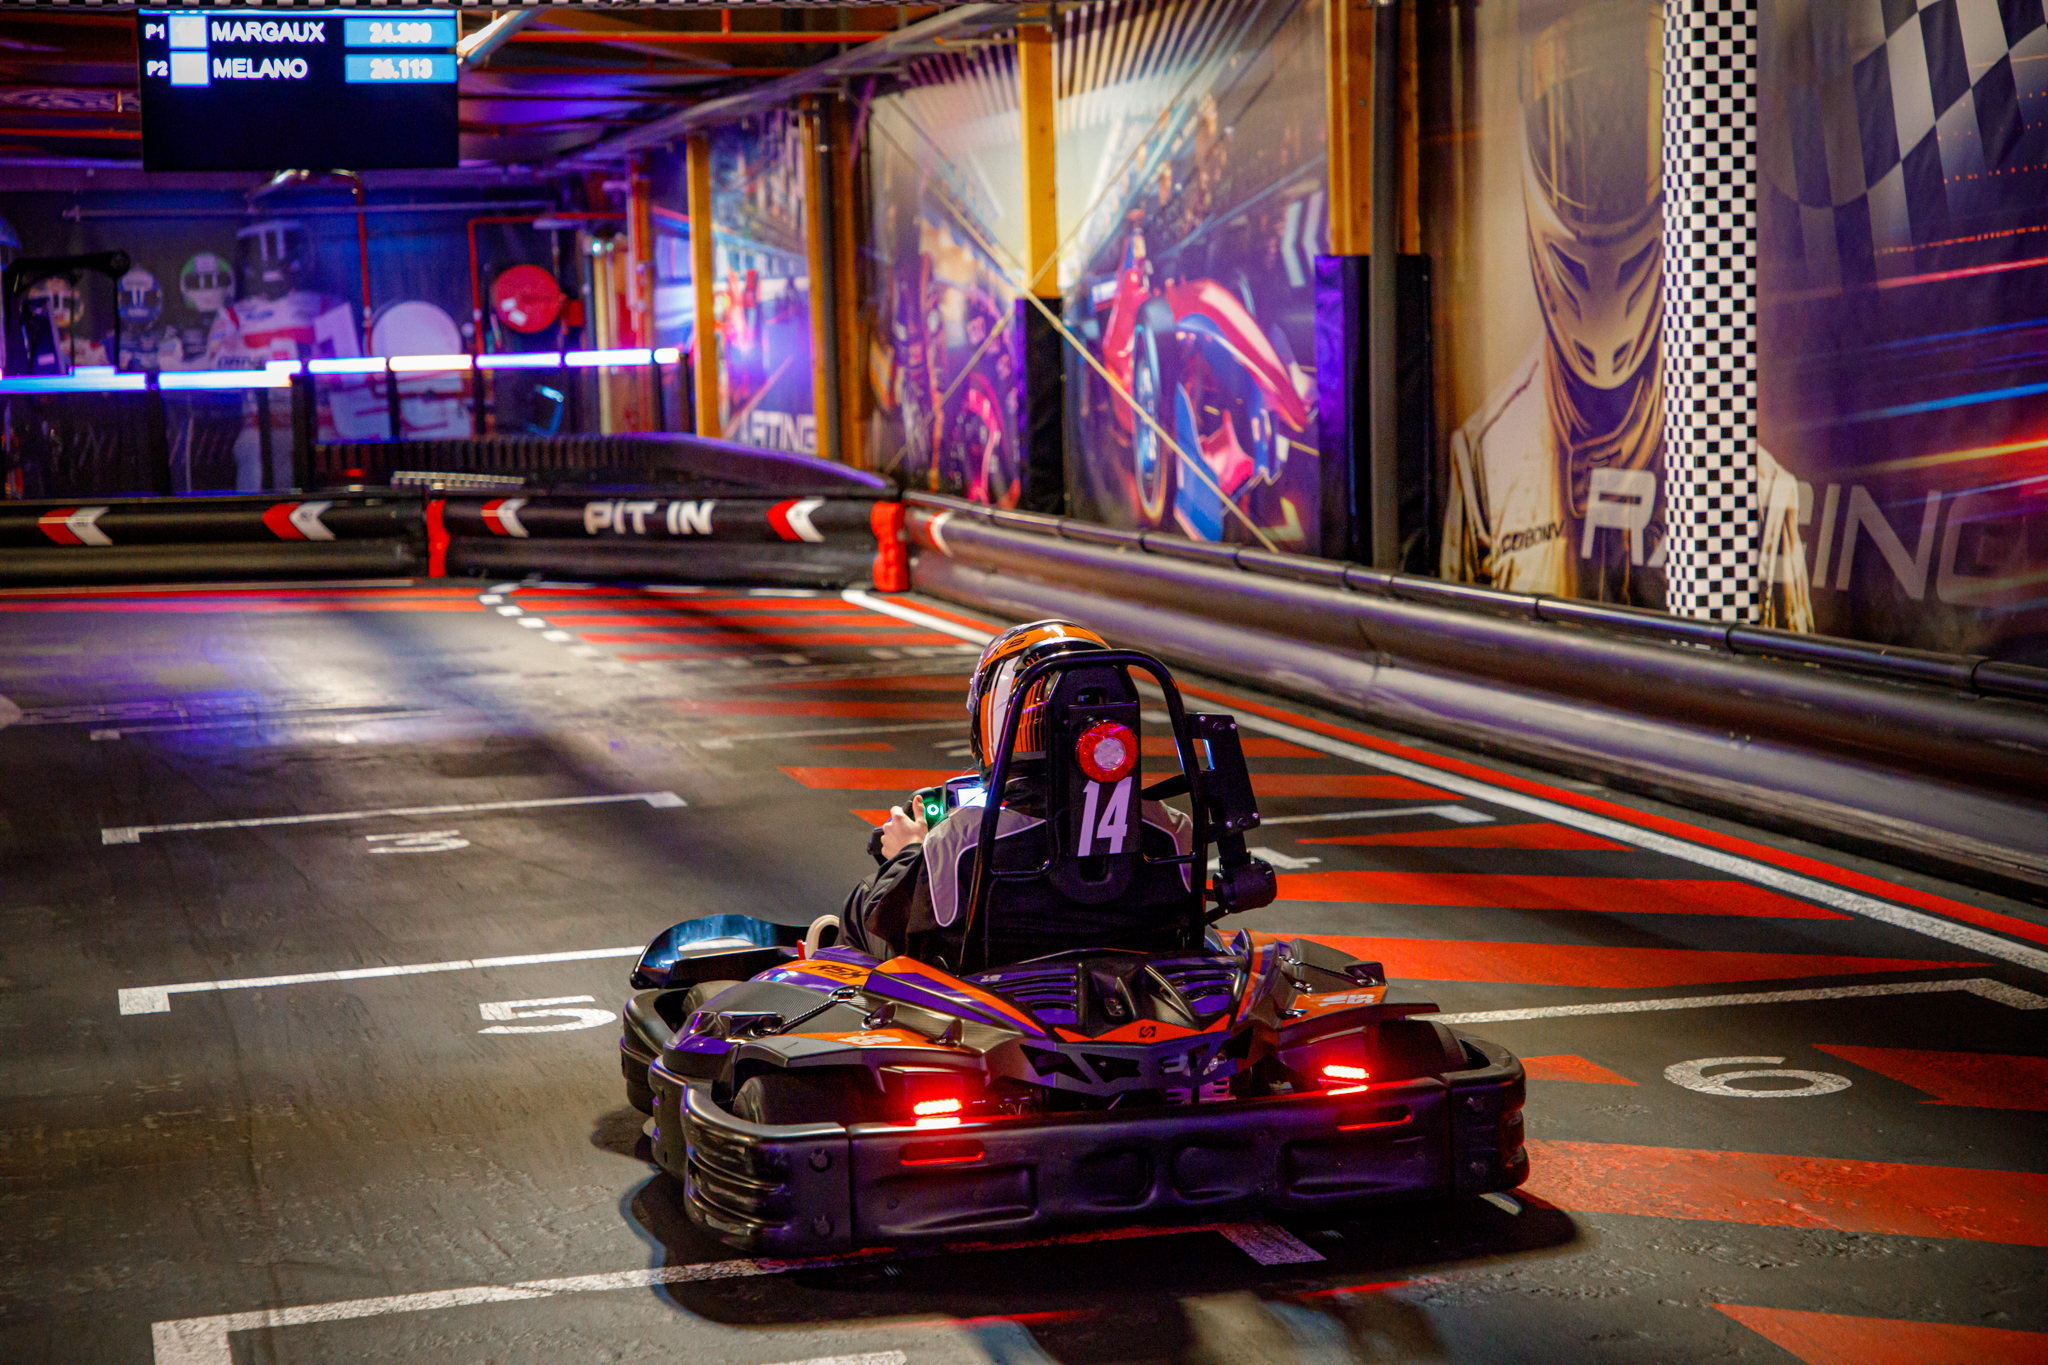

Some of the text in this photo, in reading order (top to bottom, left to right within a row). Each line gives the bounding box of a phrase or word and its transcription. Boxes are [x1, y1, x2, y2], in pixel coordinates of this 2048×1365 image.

[145, 23, 166, 43] P1
[212, 21, 326, 43] MARGAUX
[146, 60, 169, 77] P2
[213, 58, 308, 80] MELANO
[583, 500, 716, 535] PIT IN
[1581, 467, 2030, 608] RING
[1077, 776, 1133, 857] 14
[365, 829, 470, 854] 3
[477, 995, 618, 1034] 5
[1663, 1056, 1852, 1098] 6
